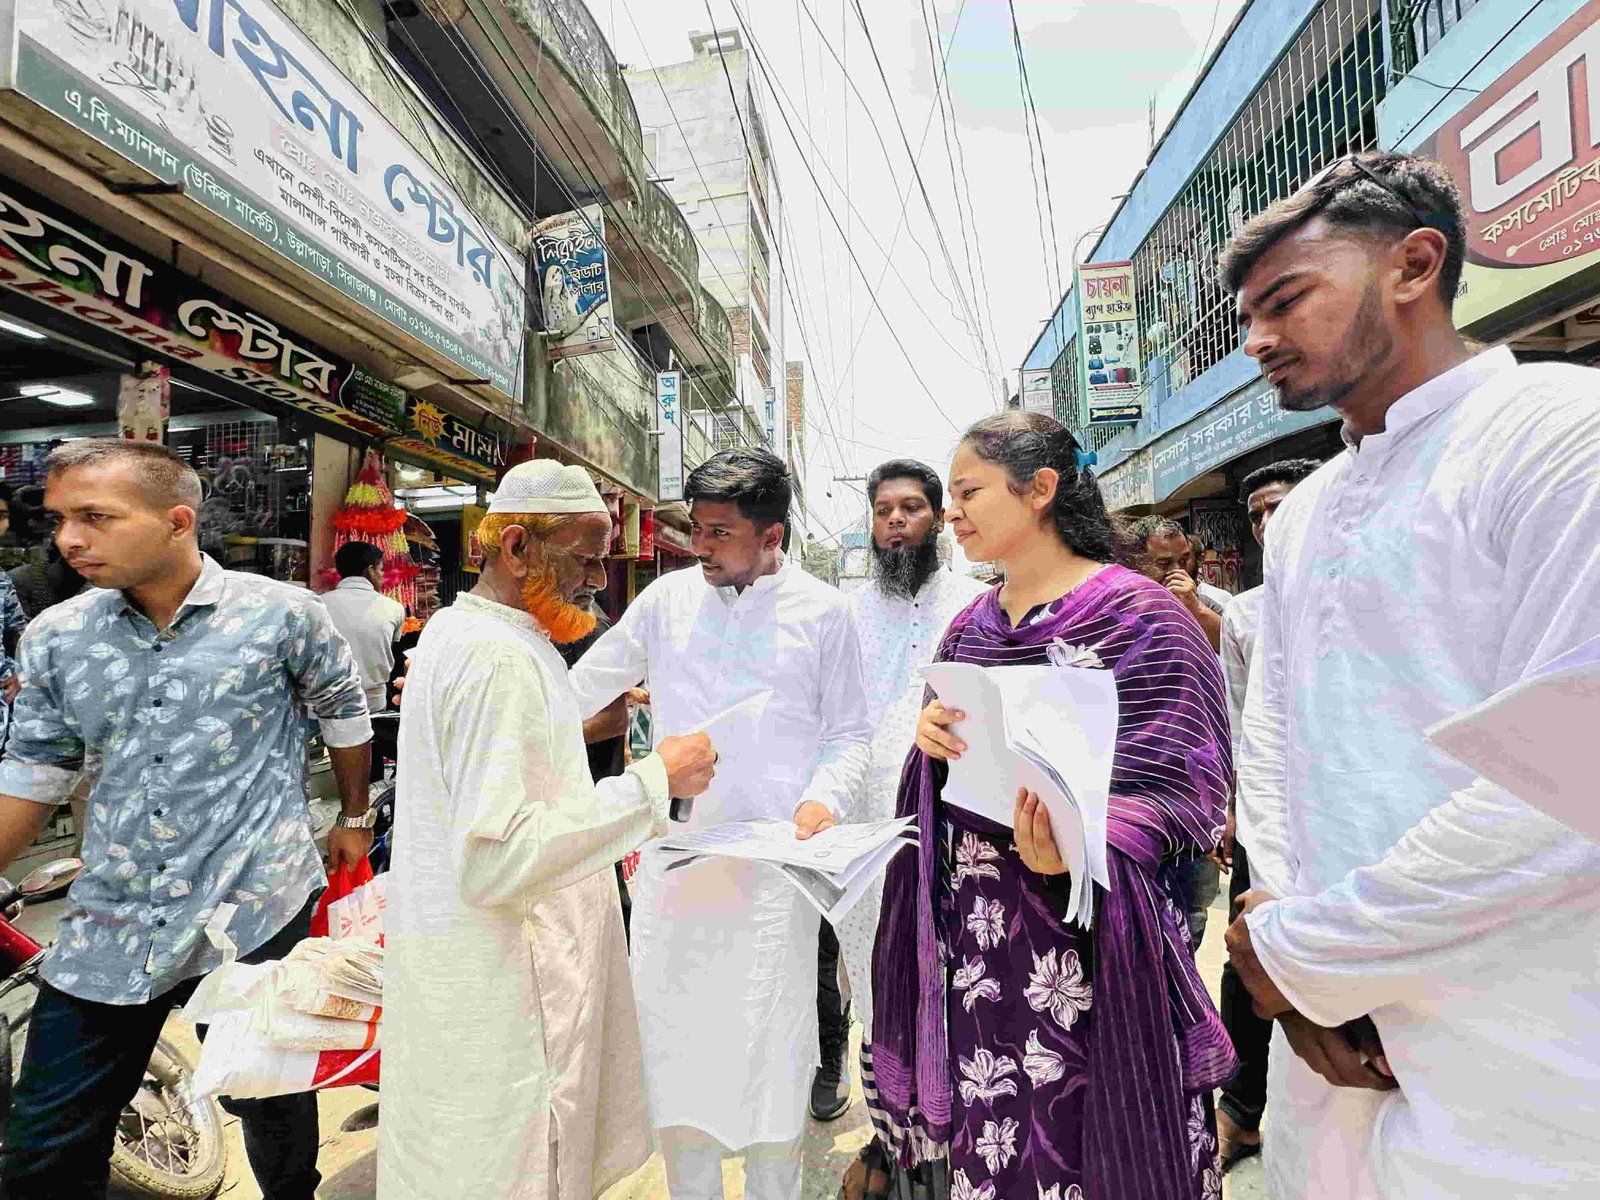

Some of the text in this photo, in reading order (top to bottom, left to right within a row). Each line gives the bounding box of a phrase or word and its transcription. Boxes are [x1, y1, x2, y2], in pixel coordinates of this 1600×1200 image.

[184, 161, 232, 208] (উকিল
[253, 148, 295, 186] এখানে
[298, 181, 362, 238] দেশী-বিদেশী
[413, 268, 426, 287] সহ
[384, 164, 495, 289] স্টোর
[1539, 228, 1567, 252] প্রোঃ
[279, 185, 327, 232] মালামাল
[331, 226, 371, 263] পাইকারী
[373, 257, 380, 270] ও
[383, 264, 404, 287] খুচরা
[429, 296, 443, 316] করা
[568, 262, 603, 281] বিউটি
[0, 266, 204, 360] hona
[570, 280, 605, 297] পার্লার
[1084, 272, 1132, 299] চায়না
[1085, 303, 1104, 320] ব্যাগ
[178, 299, 337, 394] স্টোর
[1153, 430, 1190, 469] মেসার্স
[1190, 400, 1253, 444] সরকার
